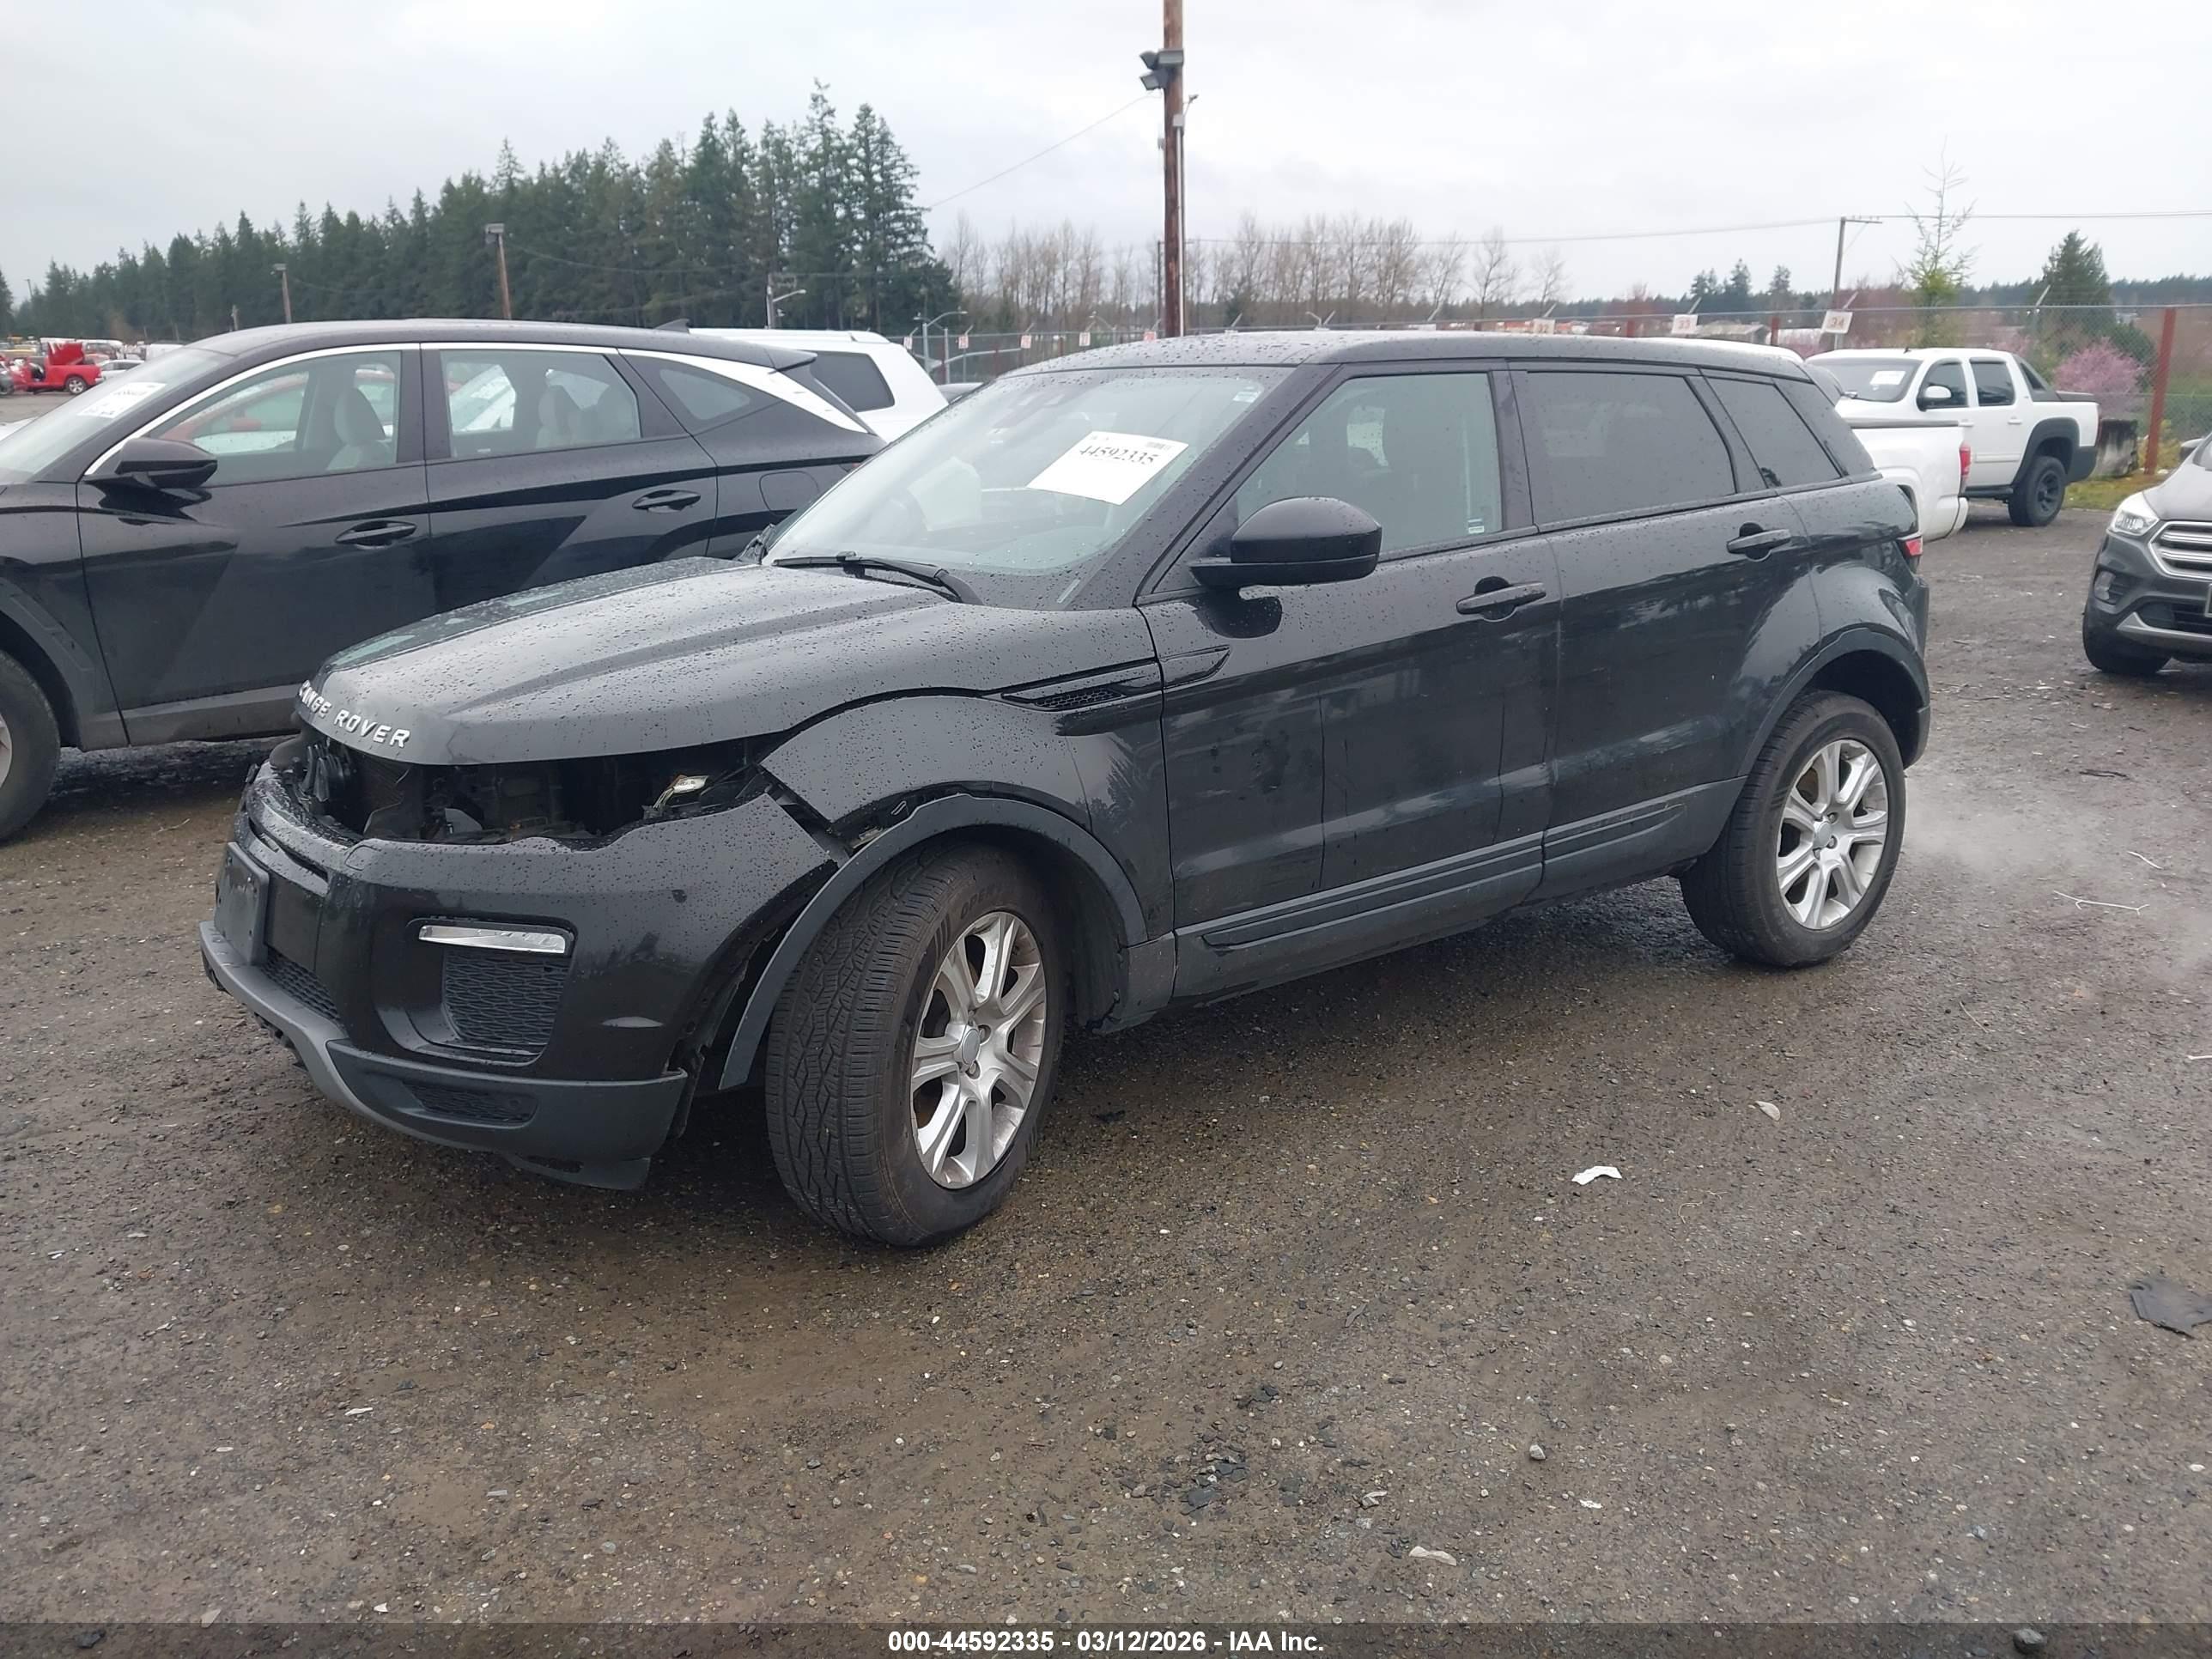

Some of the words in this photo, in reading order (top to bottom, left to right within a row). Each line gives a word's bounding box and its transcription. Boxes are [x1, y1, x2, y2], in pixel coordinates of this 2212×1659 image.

[1079, 446, 1159, 465] 44592335
[299, 680, 331, 718] RANGE
[334, 709, 410, 748] ROVER
